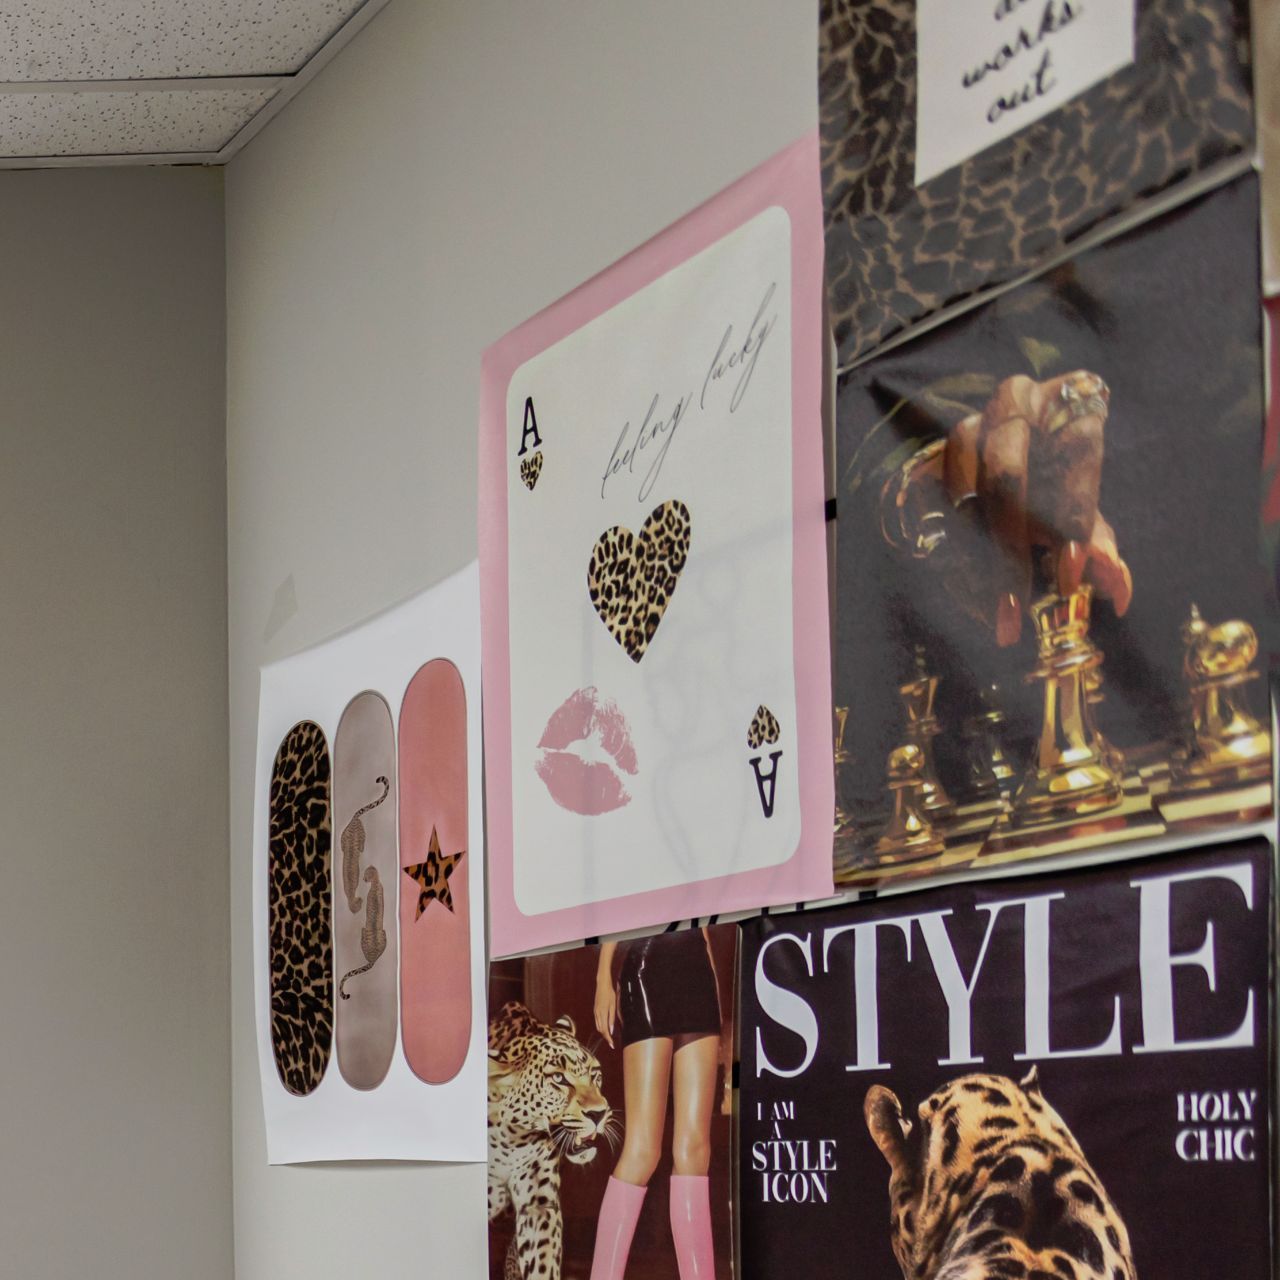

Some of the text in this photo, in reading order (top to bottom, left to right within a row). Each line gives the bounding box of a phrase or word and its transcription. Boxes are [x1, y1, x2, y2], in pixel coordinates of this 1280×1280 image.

[962, 0, 1081, 88] works
[987, 47, 1057, 122] out
[601, 281, 777, 503] feeling lucky
[518, 396, 542, 456] A
[748, 750, 783, 819] A
[754, 863, 1255, 1079] STYLE
[757, 1100, 795, 1121] I AM
[1177, 1090, 1257, 1122] HOLY
[770, 1120, 781, 1140] A
[1175, 1128, 1256, 1162] CHIC
[752, 1139, 837, 1172] STYLE
[762, 1171, 829, 1204] ICON
